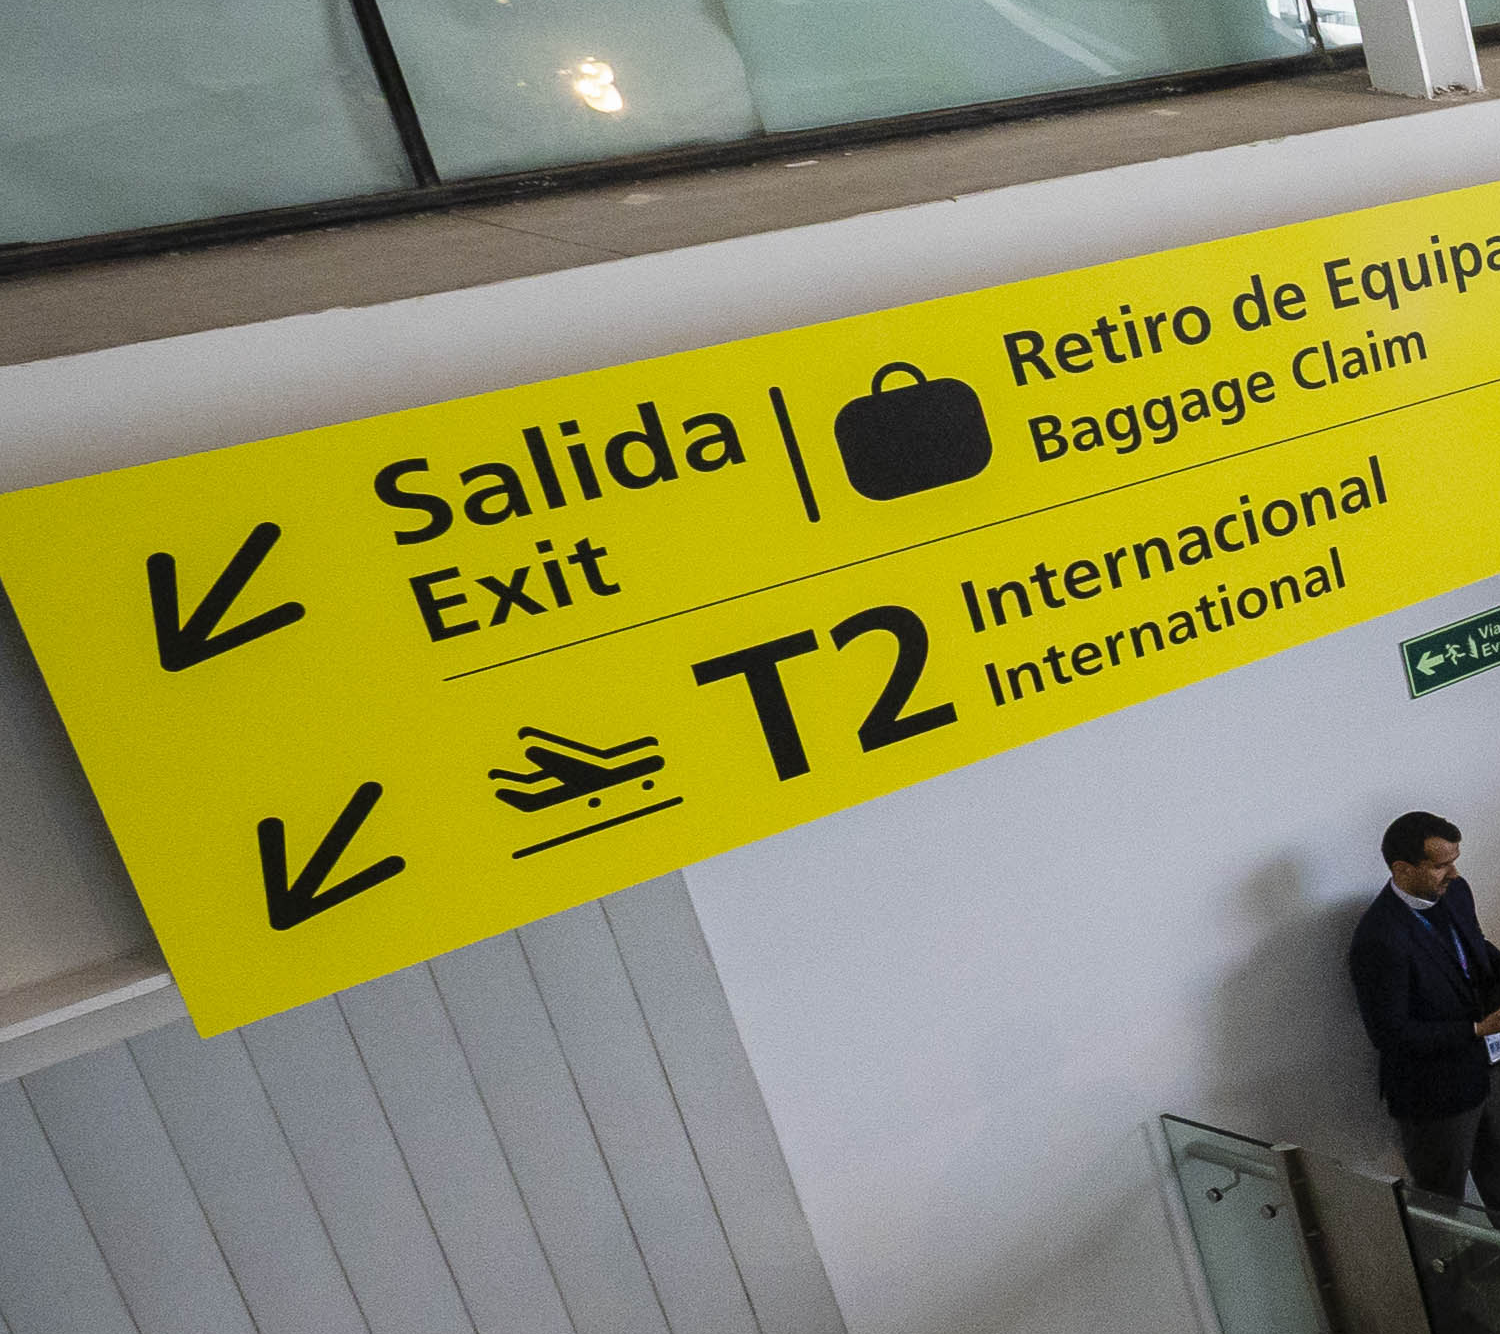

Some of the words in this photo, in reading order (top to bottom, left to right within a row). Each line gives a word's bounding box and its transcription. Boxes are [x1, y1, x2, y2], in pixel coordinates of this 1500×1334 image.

[1003, 304, 1211, 387] Retiro
[1233, 274, 1307, 331] de
[1028, 371, 1275, 463] Baggage
[1292, 330, 1427, 390] Claim
[373, 401, 746, 546] Salida
[960, 455, 1387, 633] Internacional
[408, 537, 622, 643] Exit
[984, 546, 1346, 707] International
[690, 605, 958, 782] T2
